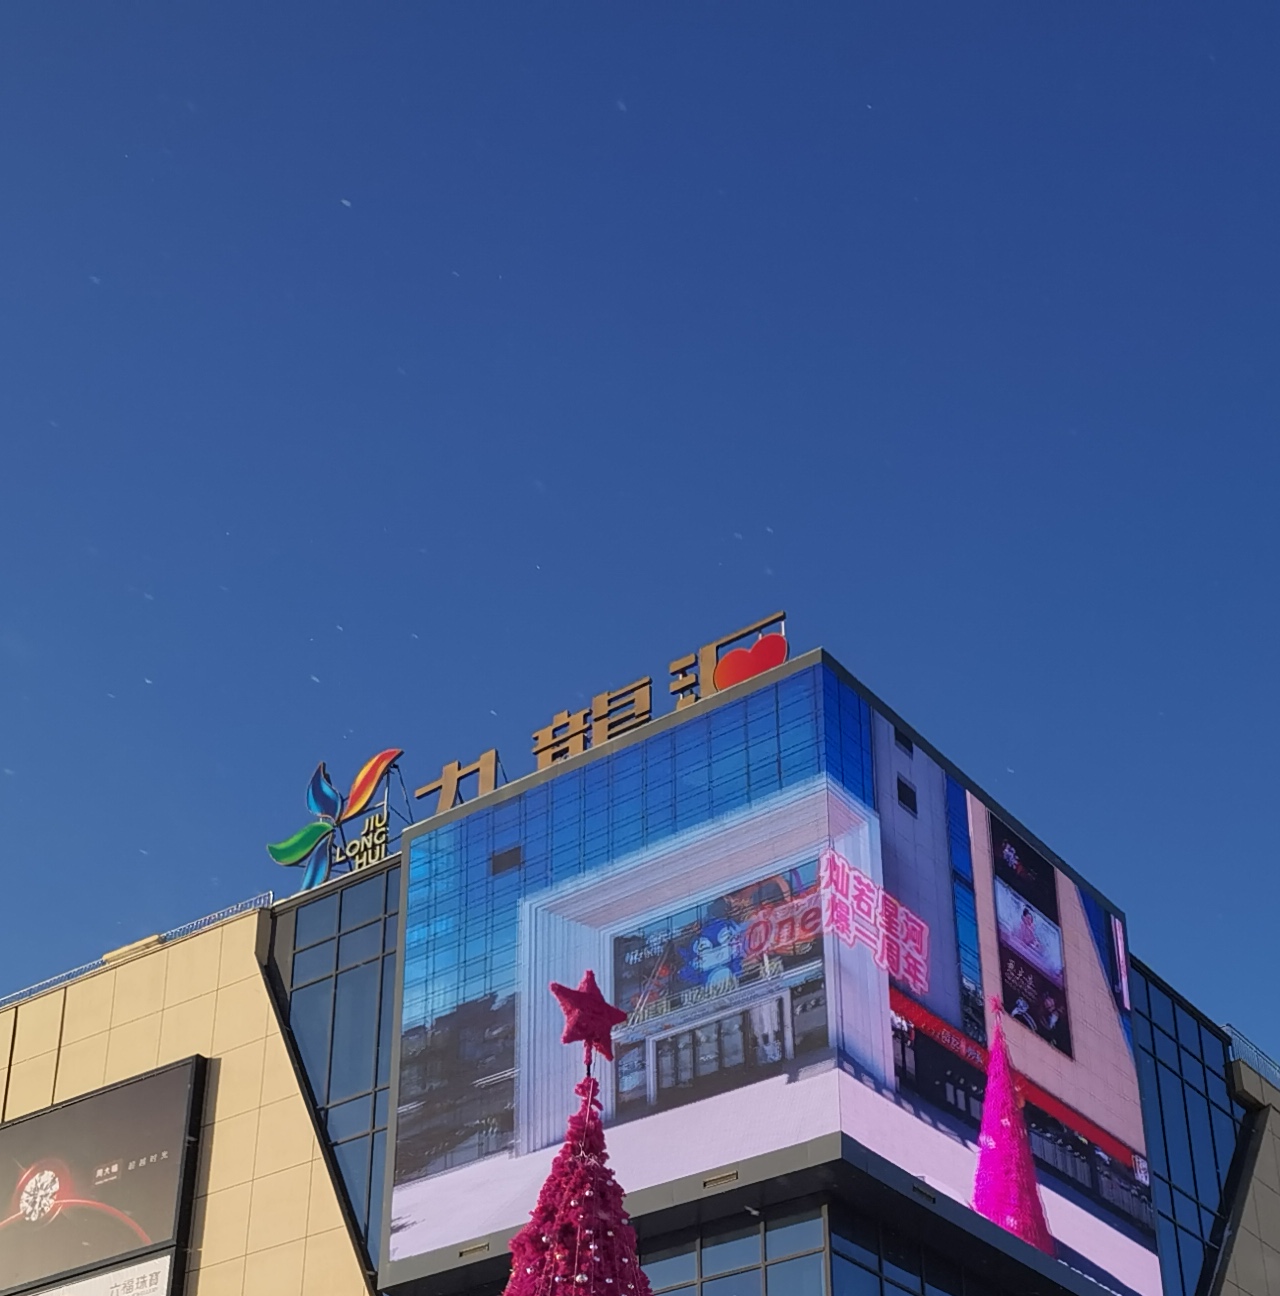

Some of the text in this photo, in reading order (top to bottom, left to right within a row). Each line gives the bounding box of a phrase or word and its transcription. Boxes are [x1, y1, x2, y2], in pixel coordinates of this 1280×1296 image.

[361, 812, 387, 835] JIU
[336, 827, 386, 862] LONG
[355, 843, 386, 870] HUI
[822, 852, 927, 957] 灿若星河
